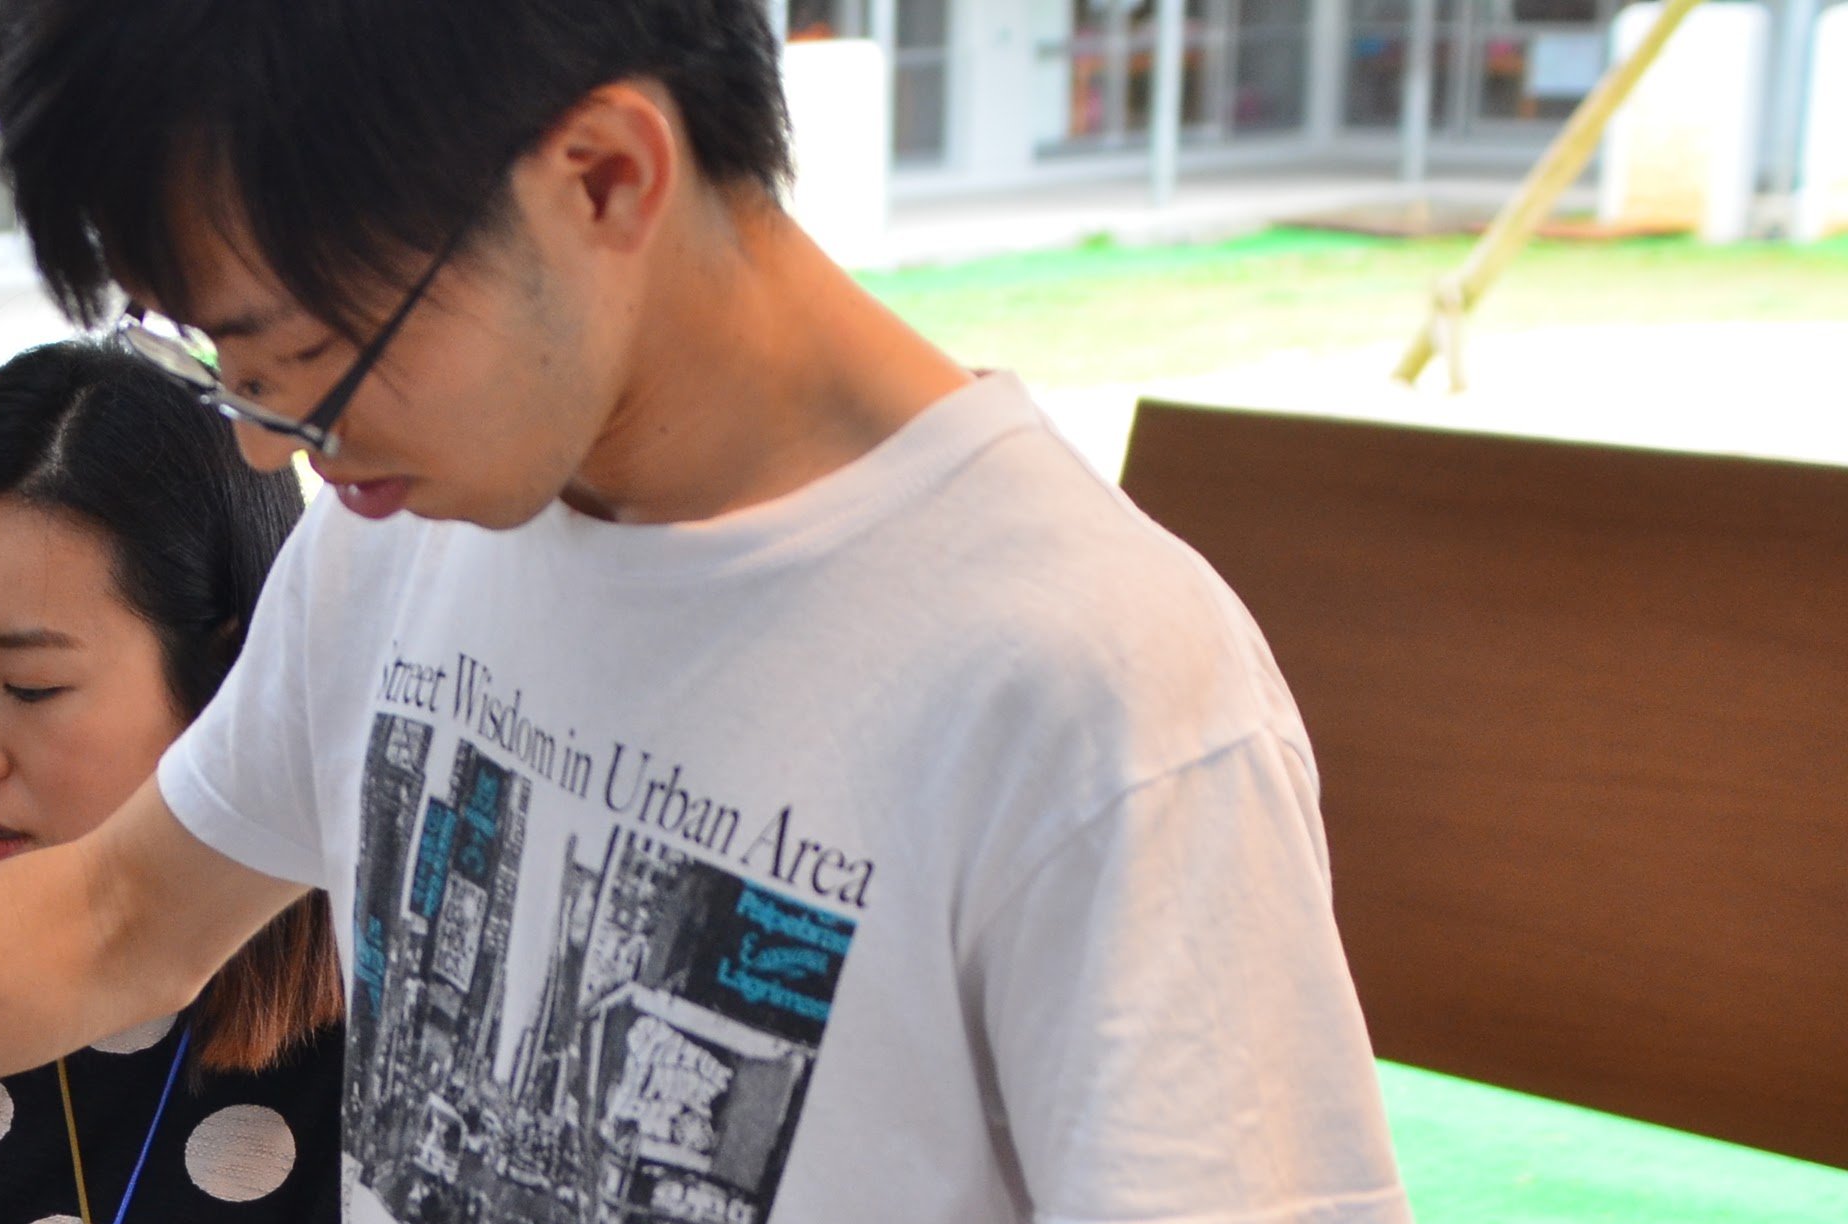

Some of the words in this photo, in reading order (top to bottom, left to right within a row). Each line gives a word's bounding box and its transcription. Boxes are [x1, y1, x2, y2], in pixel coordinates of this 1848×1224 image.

[454, 652, 555, 781] Wisdom
[559, 727, 593, 800] in
[605, 742, 740, 855] Urban
[740, 804, 873, 909] Area
